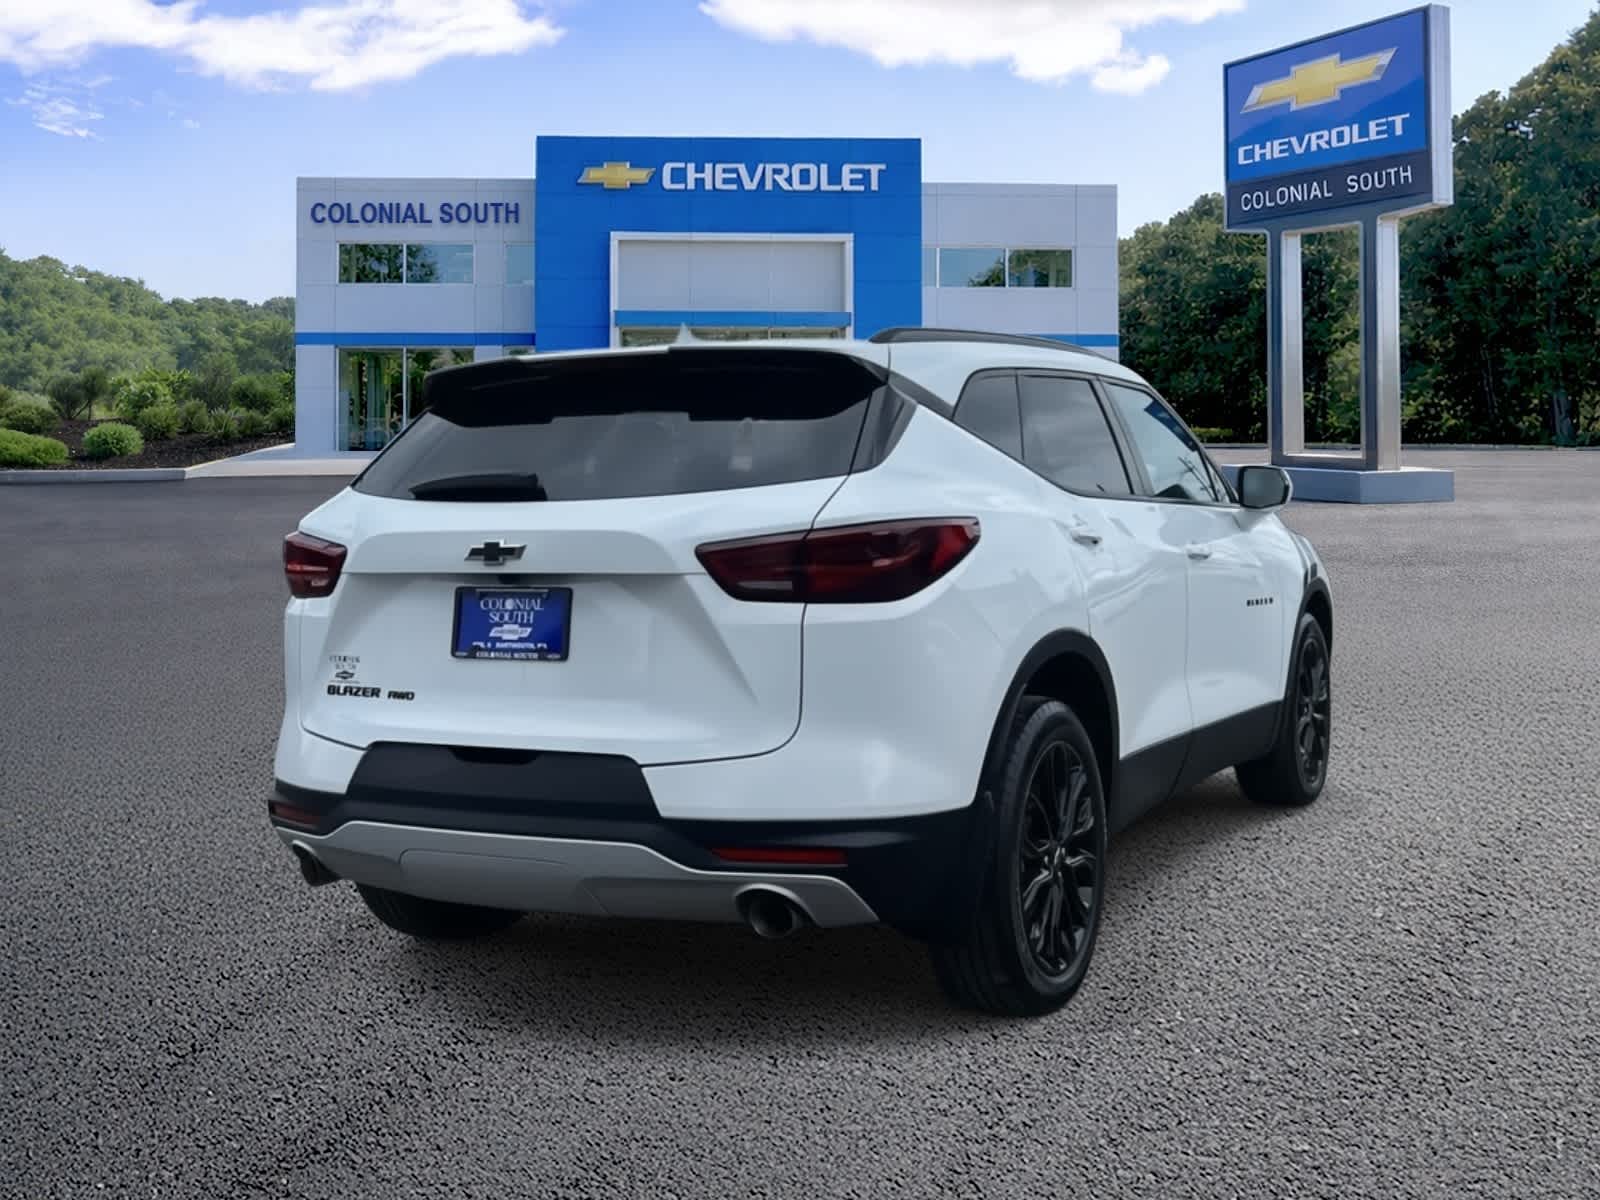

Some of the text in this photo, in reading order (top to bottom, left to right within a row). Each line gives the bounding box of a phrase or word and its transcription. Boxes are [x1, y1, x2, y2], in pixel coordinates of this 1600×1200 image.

[1238, 113, 1410, 165] CHEVROLET
[662, 162, 887, 192] CHEVROLET
[1241, 165, 1412, 211] COLONIAL SOUTH
[310, 202, 520, 224] COLONIAL SOUTH
[480, 598, 544, 610] COLONIAL
[489, 611, 534, 624] SOUTH
[327, 684, 415, 701] BLAZER AWD
